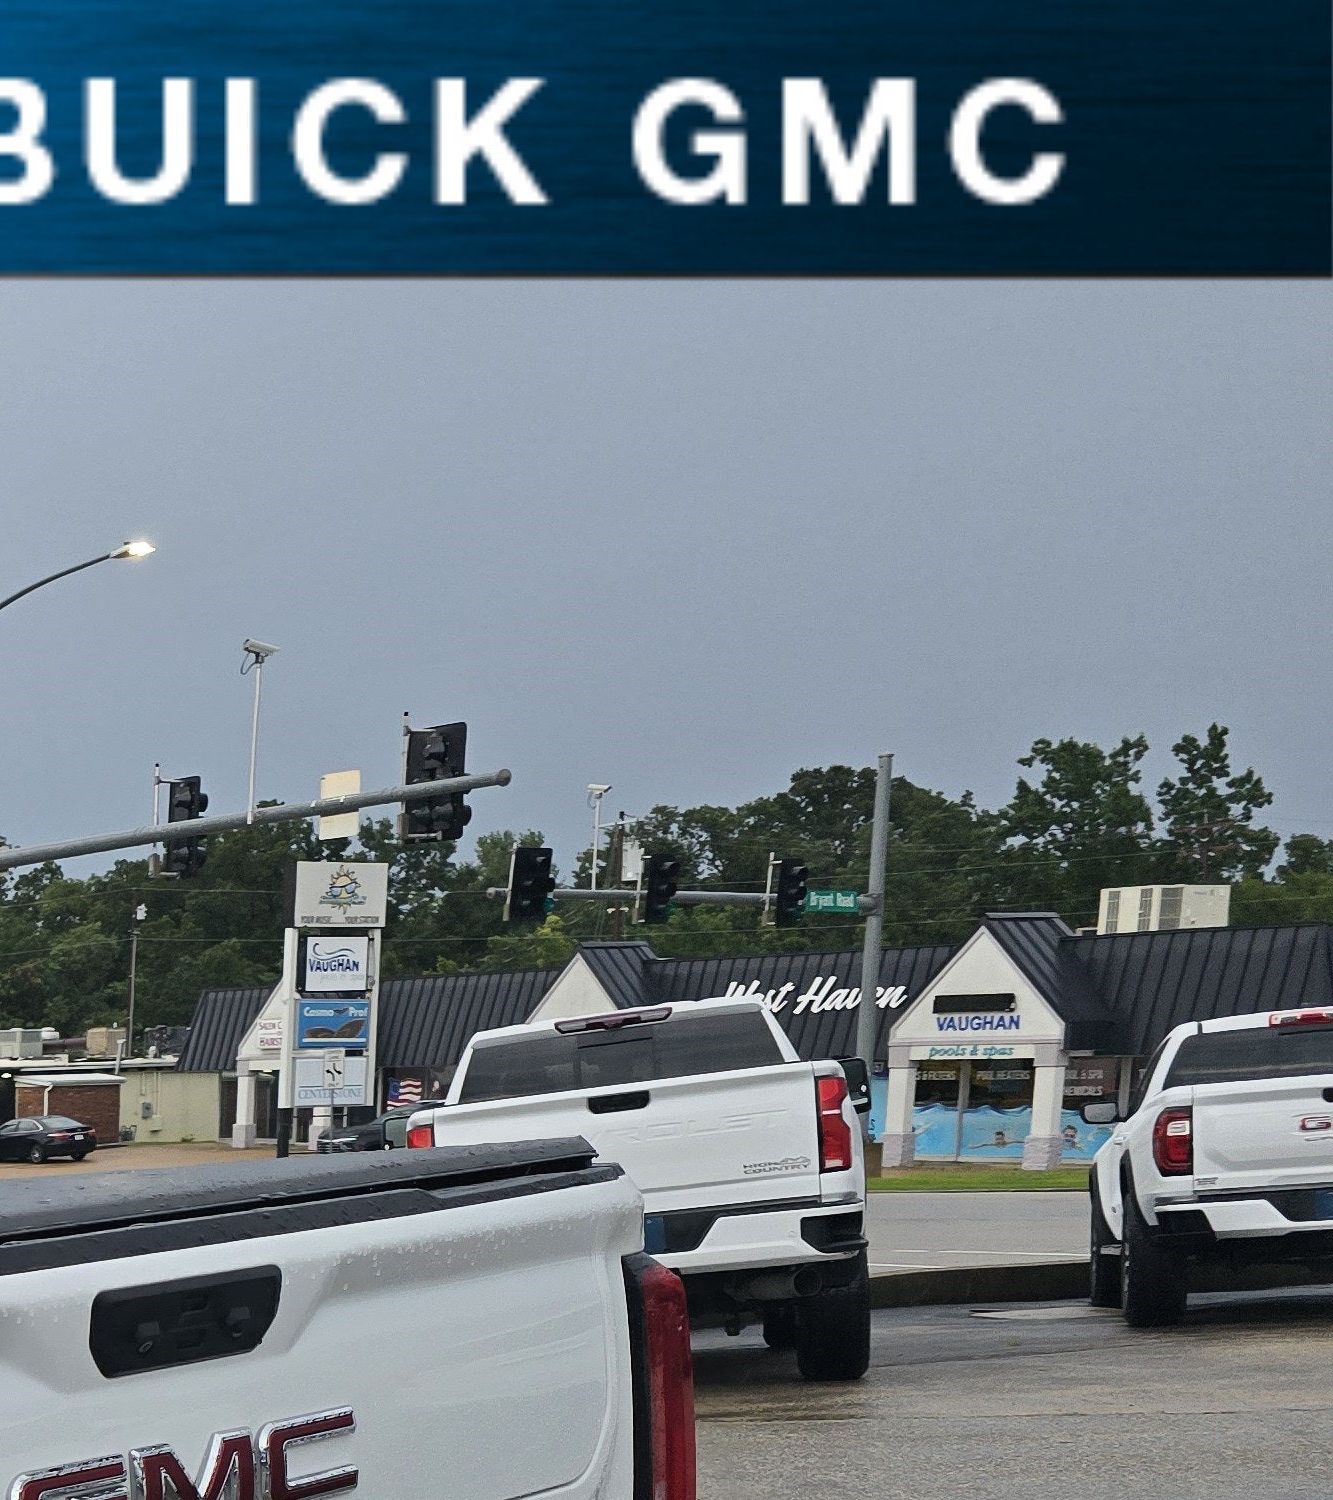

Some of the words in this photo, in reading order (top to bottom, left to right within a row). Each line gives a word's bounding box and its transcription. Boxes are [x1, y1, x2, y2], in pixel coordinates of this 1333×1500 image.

[308, 958, 360, 973] VAUGHAN
[792, 975, 908, 1015] Havn
[936, 1014, 1021, 1032] VAUGHAN
[928, 1044, 966, 1060] pools
[982, 1045, 1015, 1060] spas
[743, 1163, 811, 1175] COUNTRY
